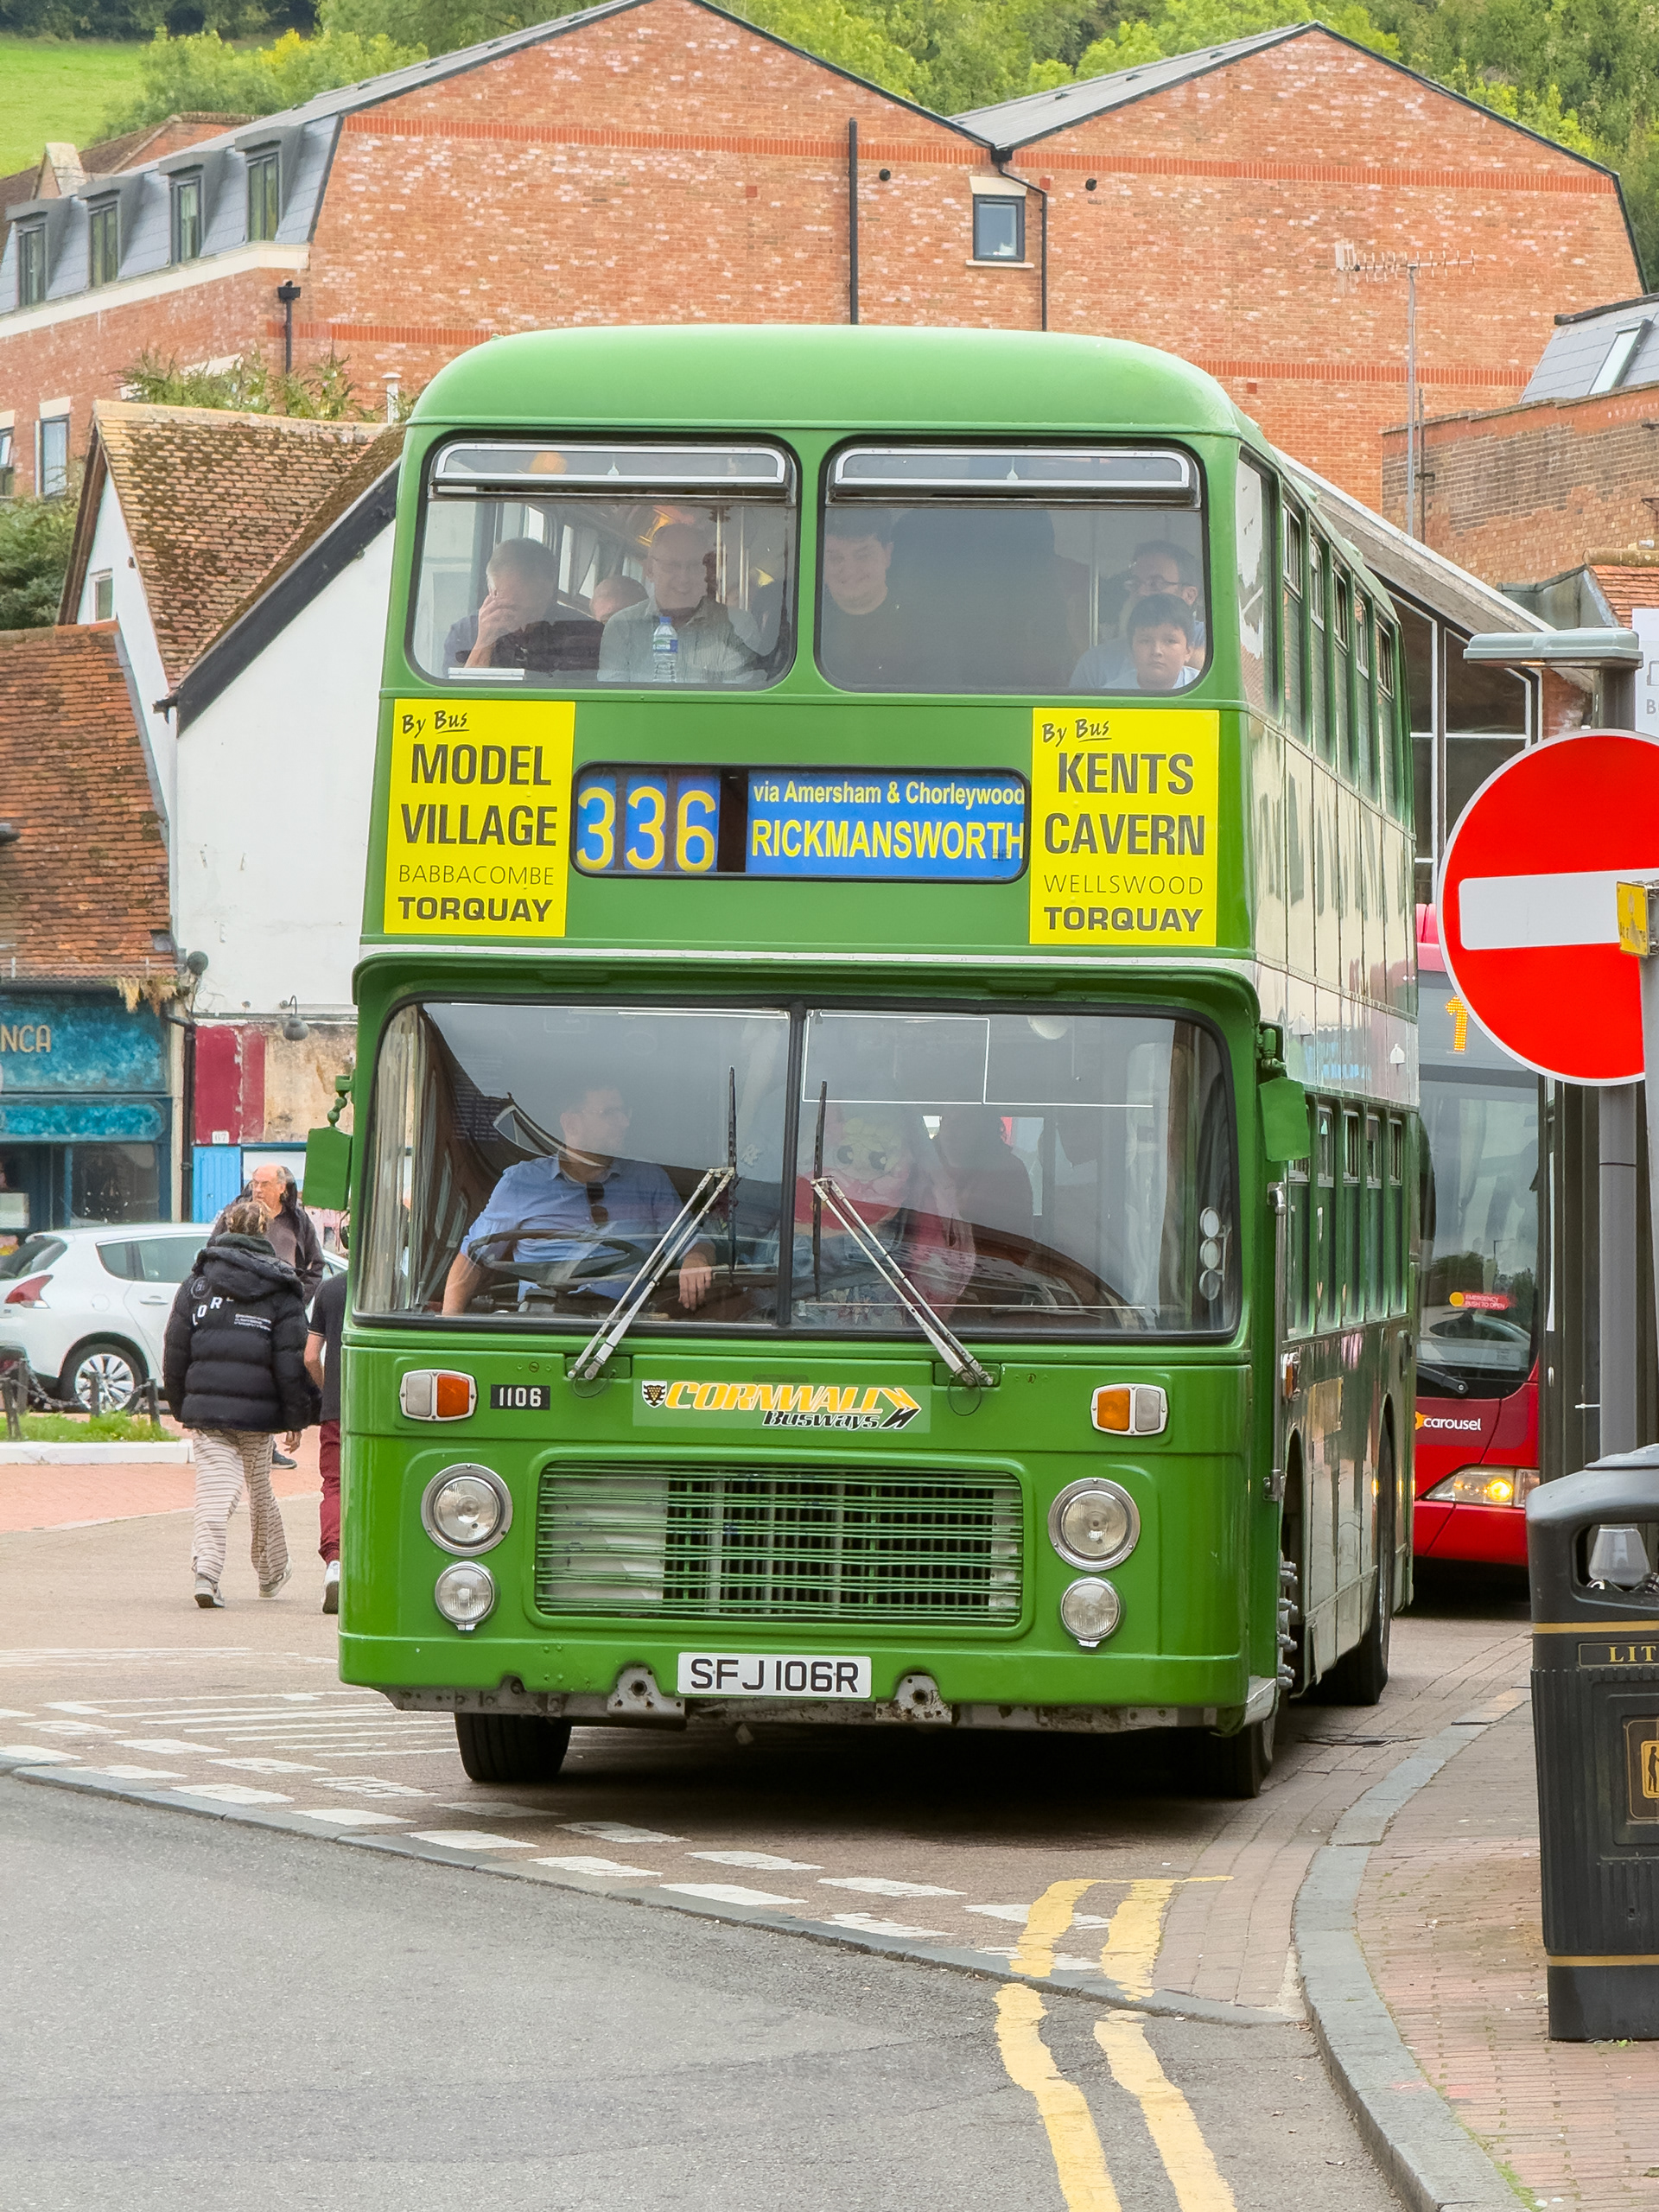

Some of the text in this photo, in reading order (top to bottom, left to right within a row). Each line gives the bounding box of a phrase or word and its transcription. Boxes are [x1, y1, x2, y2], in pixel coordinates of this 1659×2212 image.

[402, 710, 470, 739] By Bus
[1041, 718, 1113, 747] By Bus
[410, 743, 552, 786] MODEL
[1058, 752, 1195, 796] KENTS
[753, 781, 1025, 810] via Amersham & Chorleywood
[400, 803, 558, 848] VILLAGE
[576, 785, 718, 873] 336
[751, 819, 1024, 860] RICKMANSWORTH
[1044, 812, 1205, 856] CAVERN
[398, 864, 555, 887] BABBACOMBE
[1043, 874, 1205, 896] WELLSWOOD
[397, 896, 554, 923] TORQUAY
[1043, 906, 1205, 932] TORQUAY
[498, 1386, 542, 1408] 1106
[664, 1380, 883, 1414] CORNWALL
[762, 1409, 881, 1432] Busways
[1423, 1417, 1482, 1432] carousel
[1608, 1645, 1657, 1662] LIT
